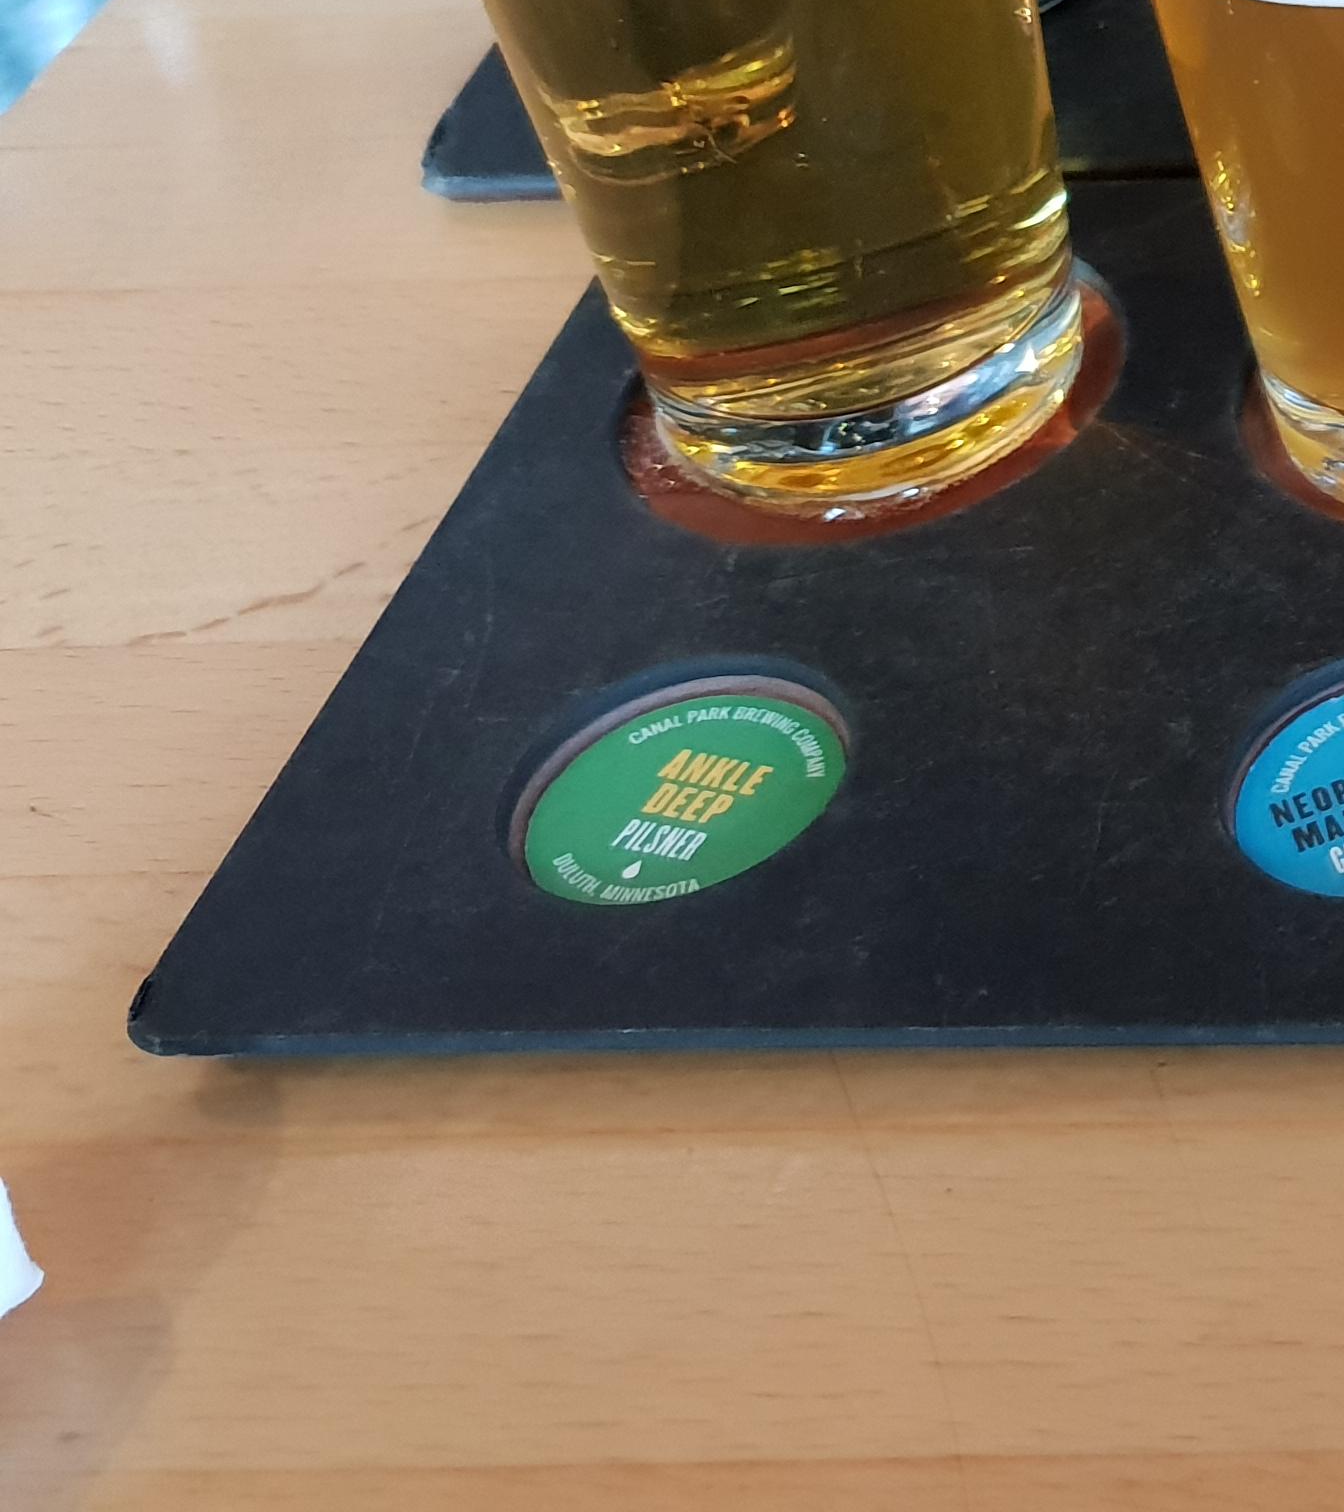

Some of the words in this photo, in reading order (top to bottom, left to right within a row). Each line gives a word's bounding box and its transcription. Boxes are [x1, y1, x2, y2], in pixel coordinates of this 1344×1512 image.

[628, 716, 682, 744] CANAL
[687, 706, 732, 724] PARK
[733, 706, 800, 734] BREWING
[791, 728, 826, 778] COMPANY
[1270, 755, 1307, 794] CANAL
[1297, 720, 1340, 756] PARK
[657, 748, 774, 796] ANKLE
[640, 783, 734, 824] DEEP
[610, 819, 707, 861] PILSNER
[599, 878, 700, 903] MINNESOTA
